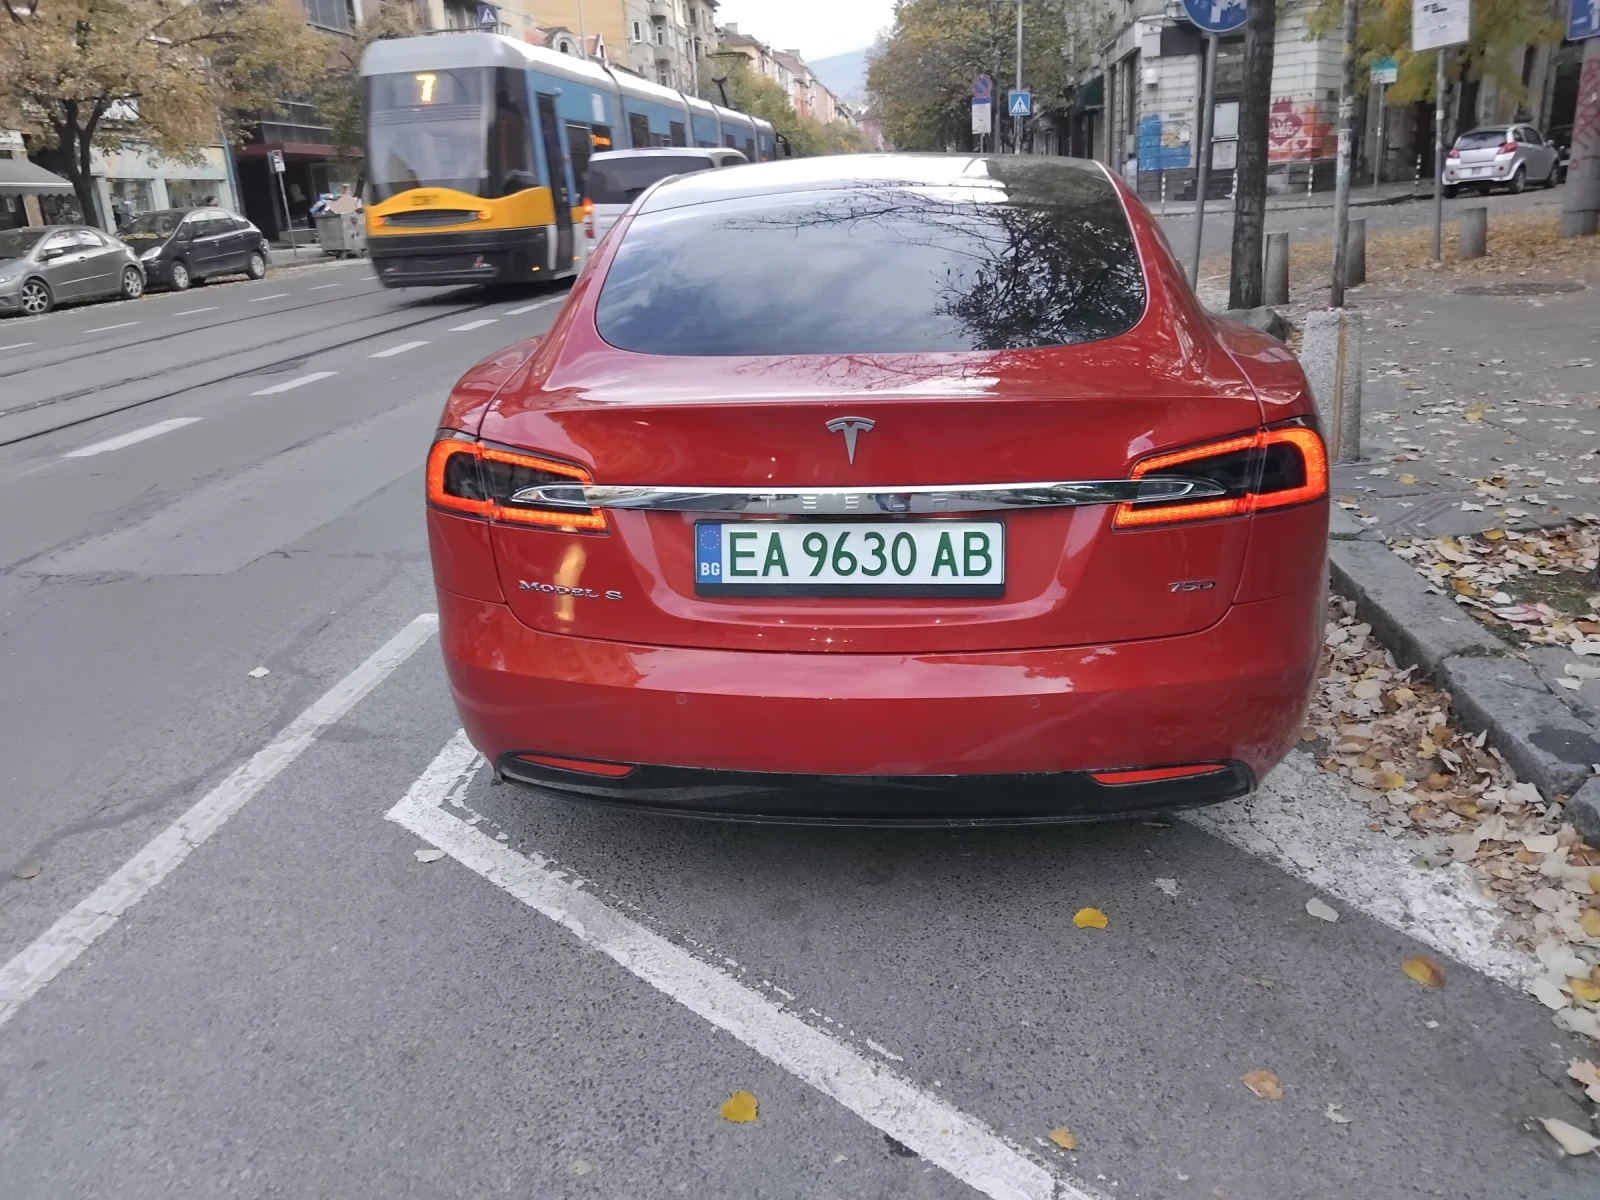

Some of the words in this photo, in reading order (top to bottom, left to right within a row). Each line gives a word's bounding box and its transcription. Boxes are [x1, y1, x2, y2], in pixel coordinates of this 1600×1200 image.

[415, 74, 437, 102] 7
[760, 492, 948, 510] TESLA
[729, 531, 789, 577] EA
[802, 531, 918, 577] 9630
[931, 531, 993, 577] AB
[700, 561, 721, 576] BG
[518, 580, 600, 599] MODEL
[605, 590, 623, 601] S
[1168, 580, 1216, 593] 75D
